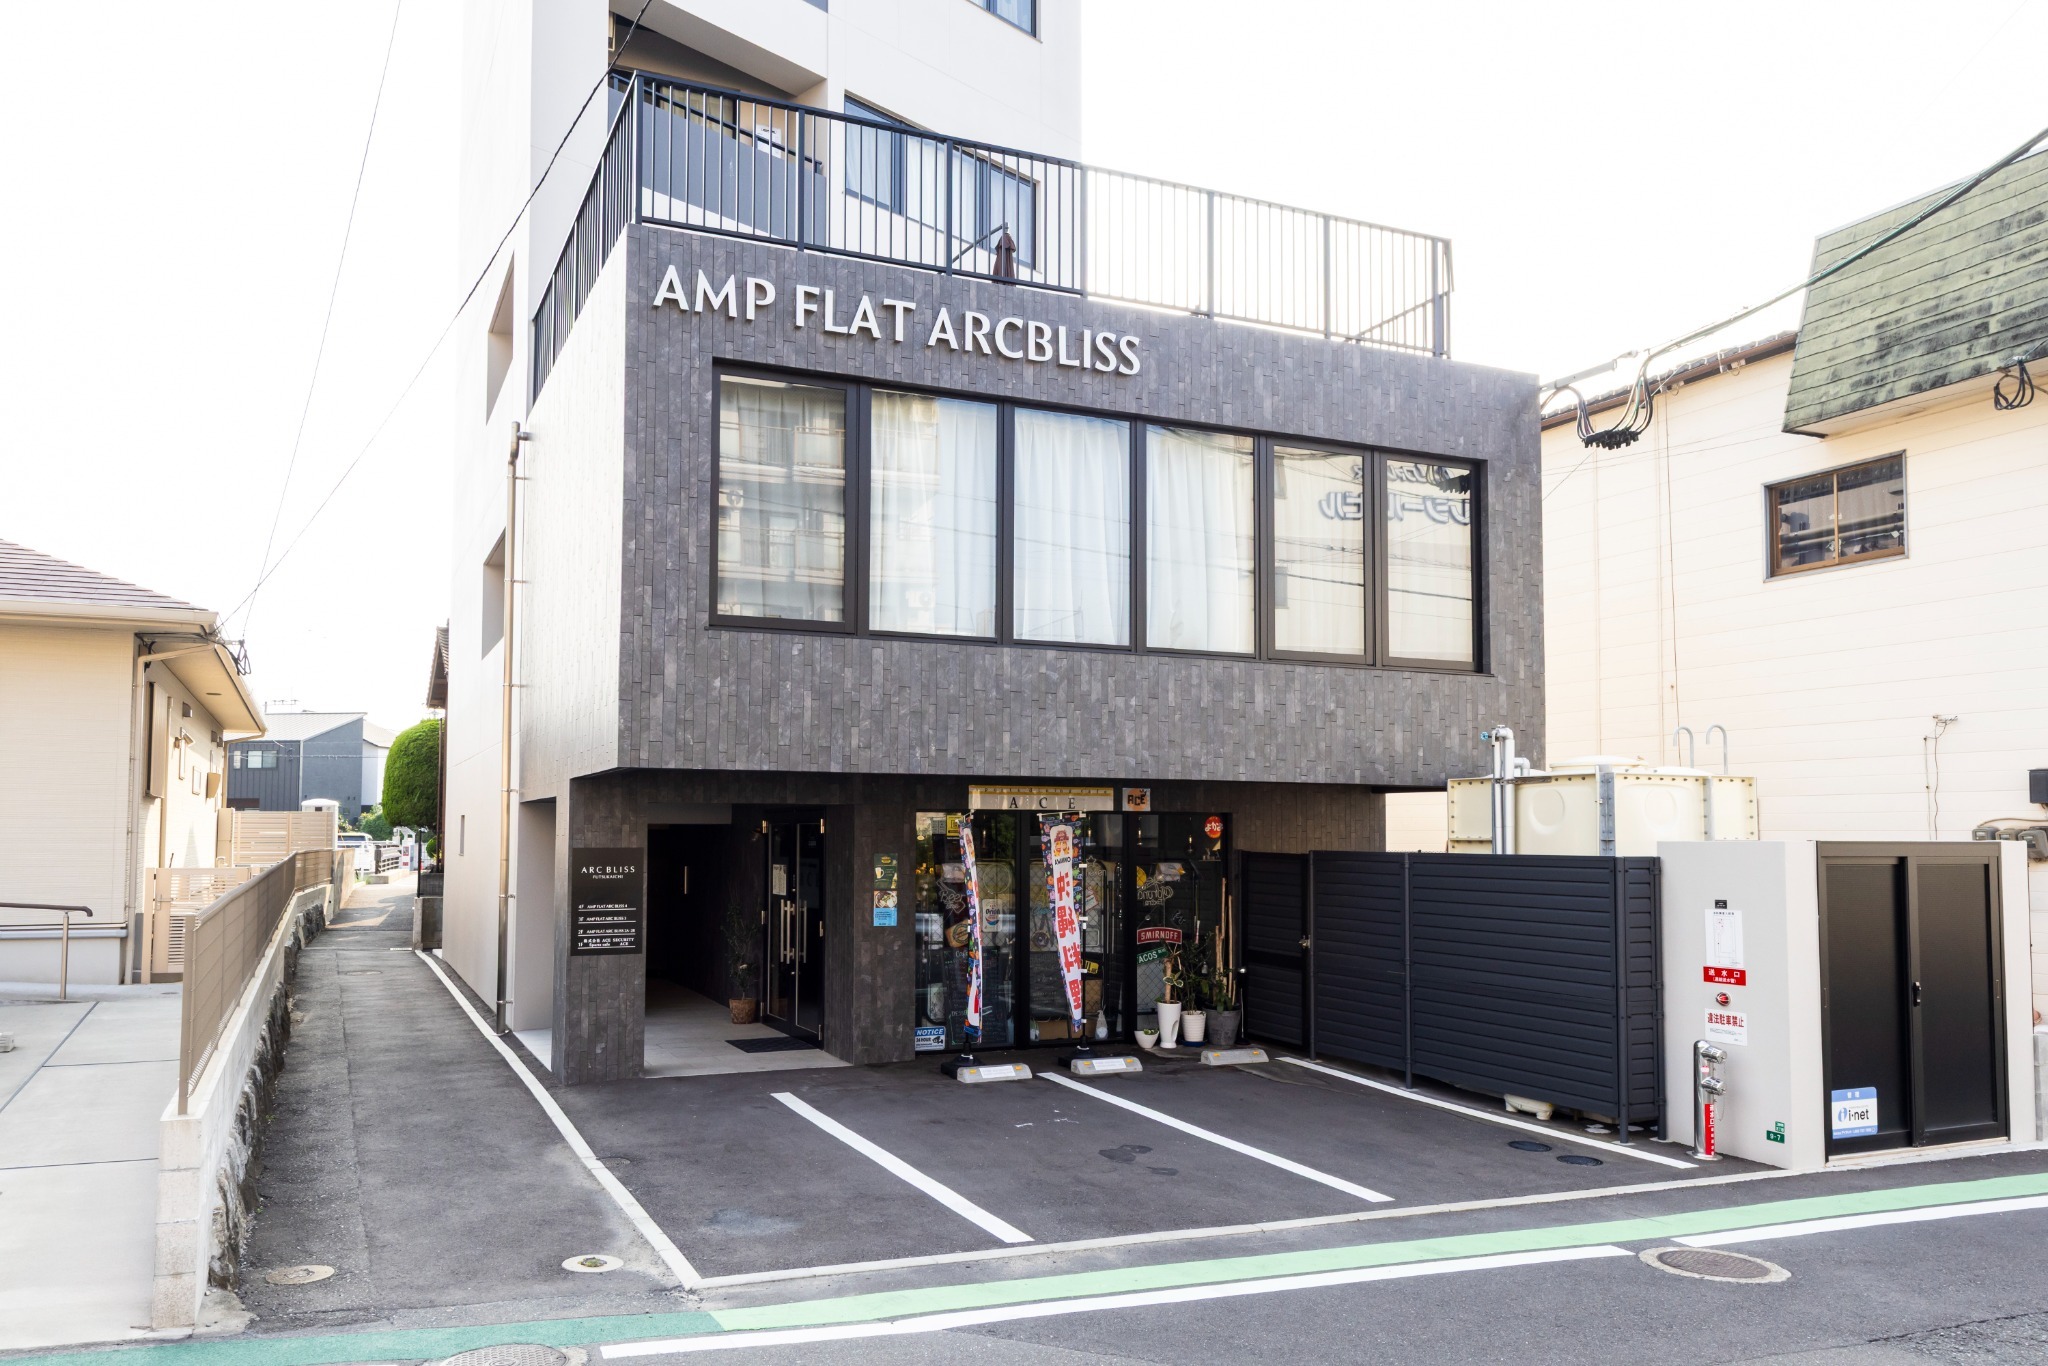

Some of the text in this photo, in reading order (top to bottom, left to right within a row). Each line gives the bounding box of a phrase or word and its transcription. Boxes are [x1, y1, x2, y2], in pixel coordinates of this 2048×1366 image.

[653, 264, 1142, 376] AMP FLAT ARCBLISS
[1127, 791, 1147, 807] ACE
[581, 866, 636, 874] ARC BLISS
[1140, 930, 1178, 941] SMIRNOFF
[1708, 968, 1740, 978] 送水口
[1707, 1012, 1744, 1028] 違法駐車禁止
[916, 1028, 944, 1036] NOTICE
